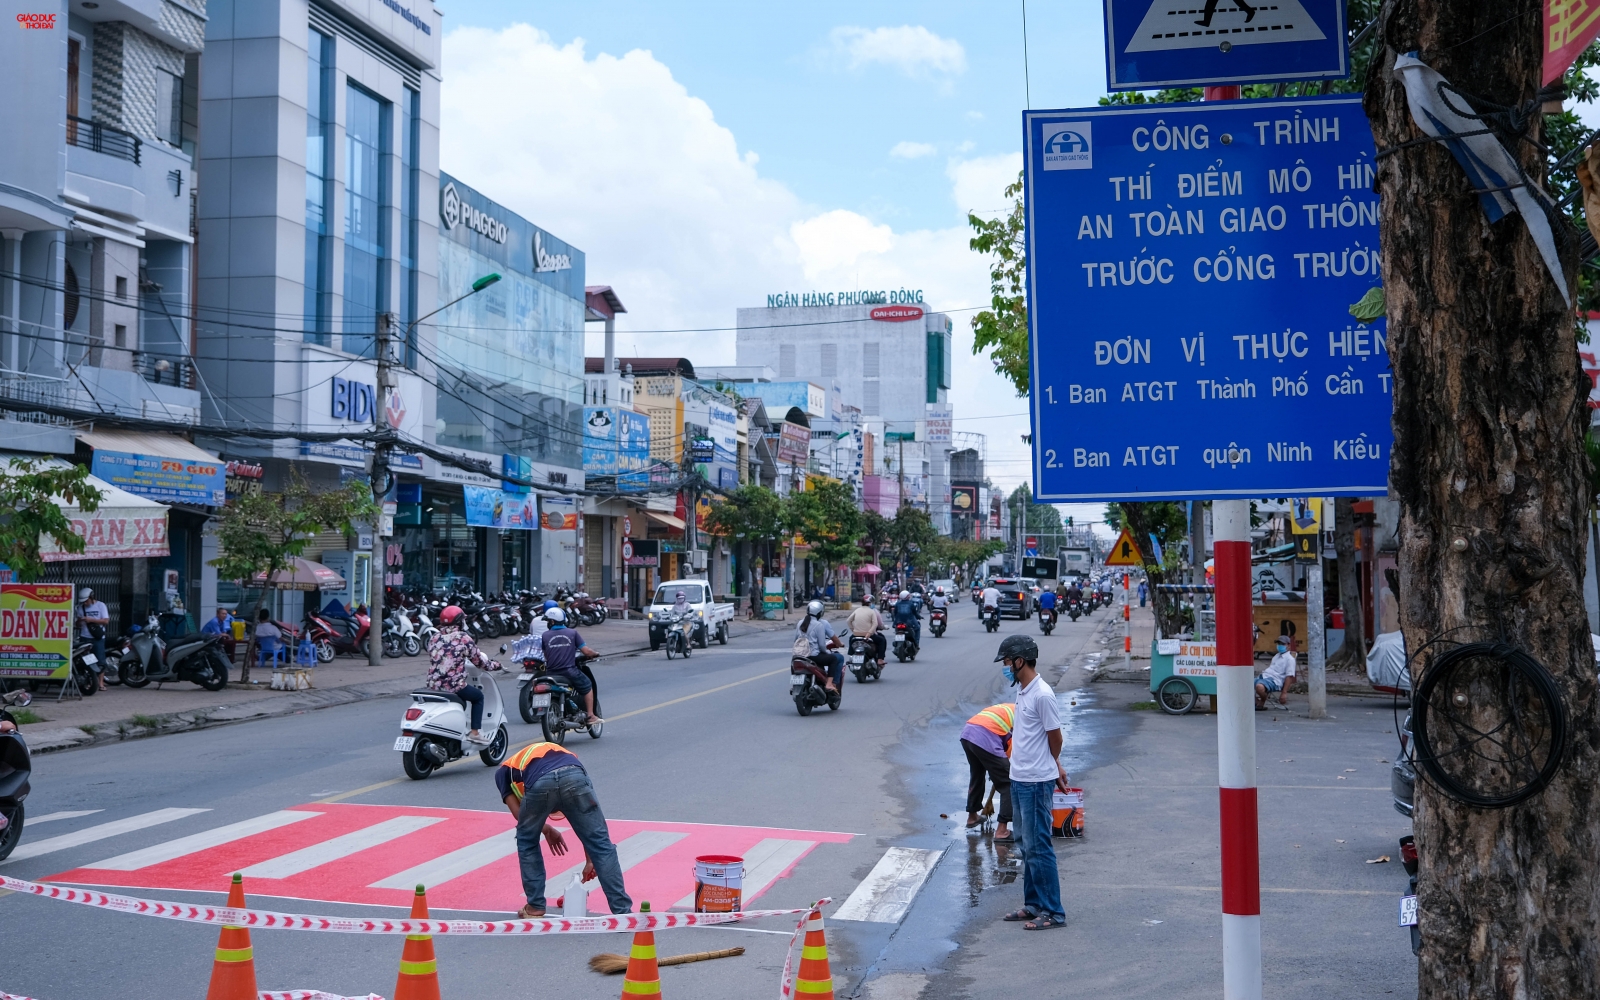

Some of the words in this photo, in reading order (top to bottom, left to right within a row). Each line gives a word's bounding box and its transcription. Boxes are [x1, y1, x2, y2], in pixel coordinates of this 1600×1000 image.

[1132, 120, 1209, 152] CÔNG
[1254, 109, 1340, 146] TRÌNH
[1109, 163, 1156, 201] THÍ
[1177, 158, 1243, 198] ĐIỂM
[1269, 159, 1312, 193] MÔ
[461, 201, 507, 244] PIAGGIO
[1077, 215, 1113, 240] AN
[1129, 204, 1204, 237] TOÀN
[1220, 205, 1287, 234] GIAO
[1303, 195, 1381, 229] THÔN
[533, 231, 571, 272] Vespa
[1082, 247, 1174, 288] TRƯỚC
[1193, 245, 1275, 284] CỔNG
[767, 291, 798, 308] NGÂN
[802, 290, 834, 307] HÀNG
[838, 290, 886, 305] PHƯƠNG
[890, 287, 923, 304] ĐÔNG
[1094, 336, 1151, 366] ĐƠN
[1181, 332, 1206, 367] VỊ
[1233, 328, 1309, 363] THỰC
[1329, 323, 1388, 362] HIỆN
[1045, 386, 1058, 404] 1.
[1069, 384, 1107, 404] Ban
[1121, 382, 1178, 403] ATGT
[1197, 376, 1257, 400] Thành
[1272, 370, 1309, 397] Phố
[1325, 365, 1364, 395] Cần
[926, 419, 952, 427] HOÀI
[100, 455, 117, 465] CÔNG
[117, 457, 123, 465] TY
[138, 458, 151, 468] DỊCH
[161, 460, 184, 473] 79
[186, 464, 217, 476] GIỜ
[1045, 449, 1064, 469] 2.
[1073, 448, 1111, 468] Ban
[1122, 446, 1180, 467] ATGT
[1267, 442, 1313, 463] Ninh
[1333, 432, 1380, 460] Kiều
[70, 510, 126, 545] DÁN
[133, 519, 166, 544] XE
[1, 601, 40, 638] DÁN
[44, 611, 69, 639] XE
[1189, 645, 1201, 659] CHỊ
